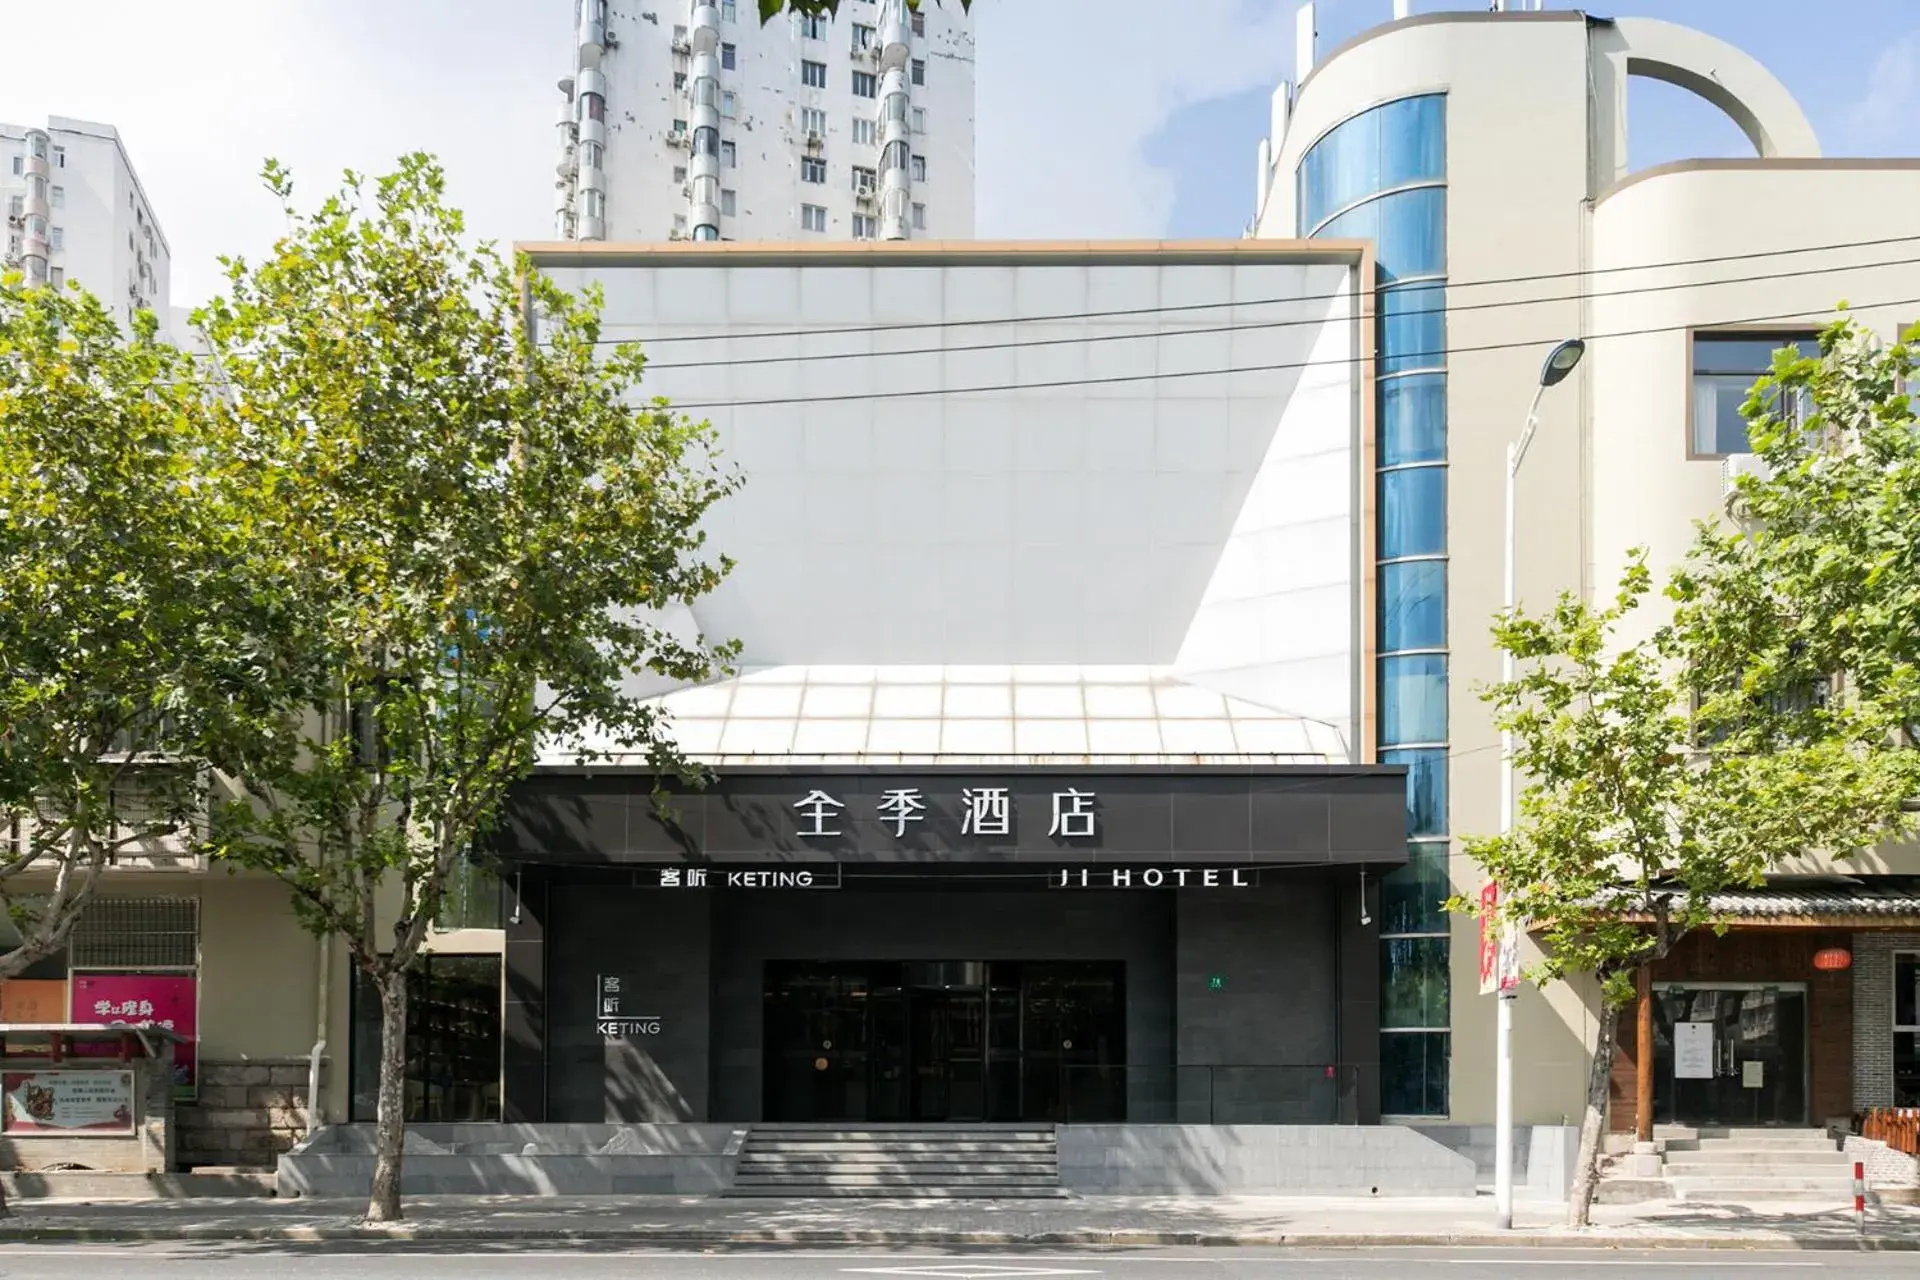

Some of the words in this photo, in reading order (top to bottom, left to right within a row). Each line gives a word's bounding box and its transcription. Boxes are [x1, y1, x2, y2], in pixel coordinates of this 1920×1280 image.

[793, 787, 1096, 838] 全季酒店
[660, 867, 707, 887] 客听
[727, 870, 814, 888] KETING
[1060, 868, 1088, 888] JI
[1112, 867, 1249, 888] HOTEL
[596, 1021, 661, 1035] KETING
